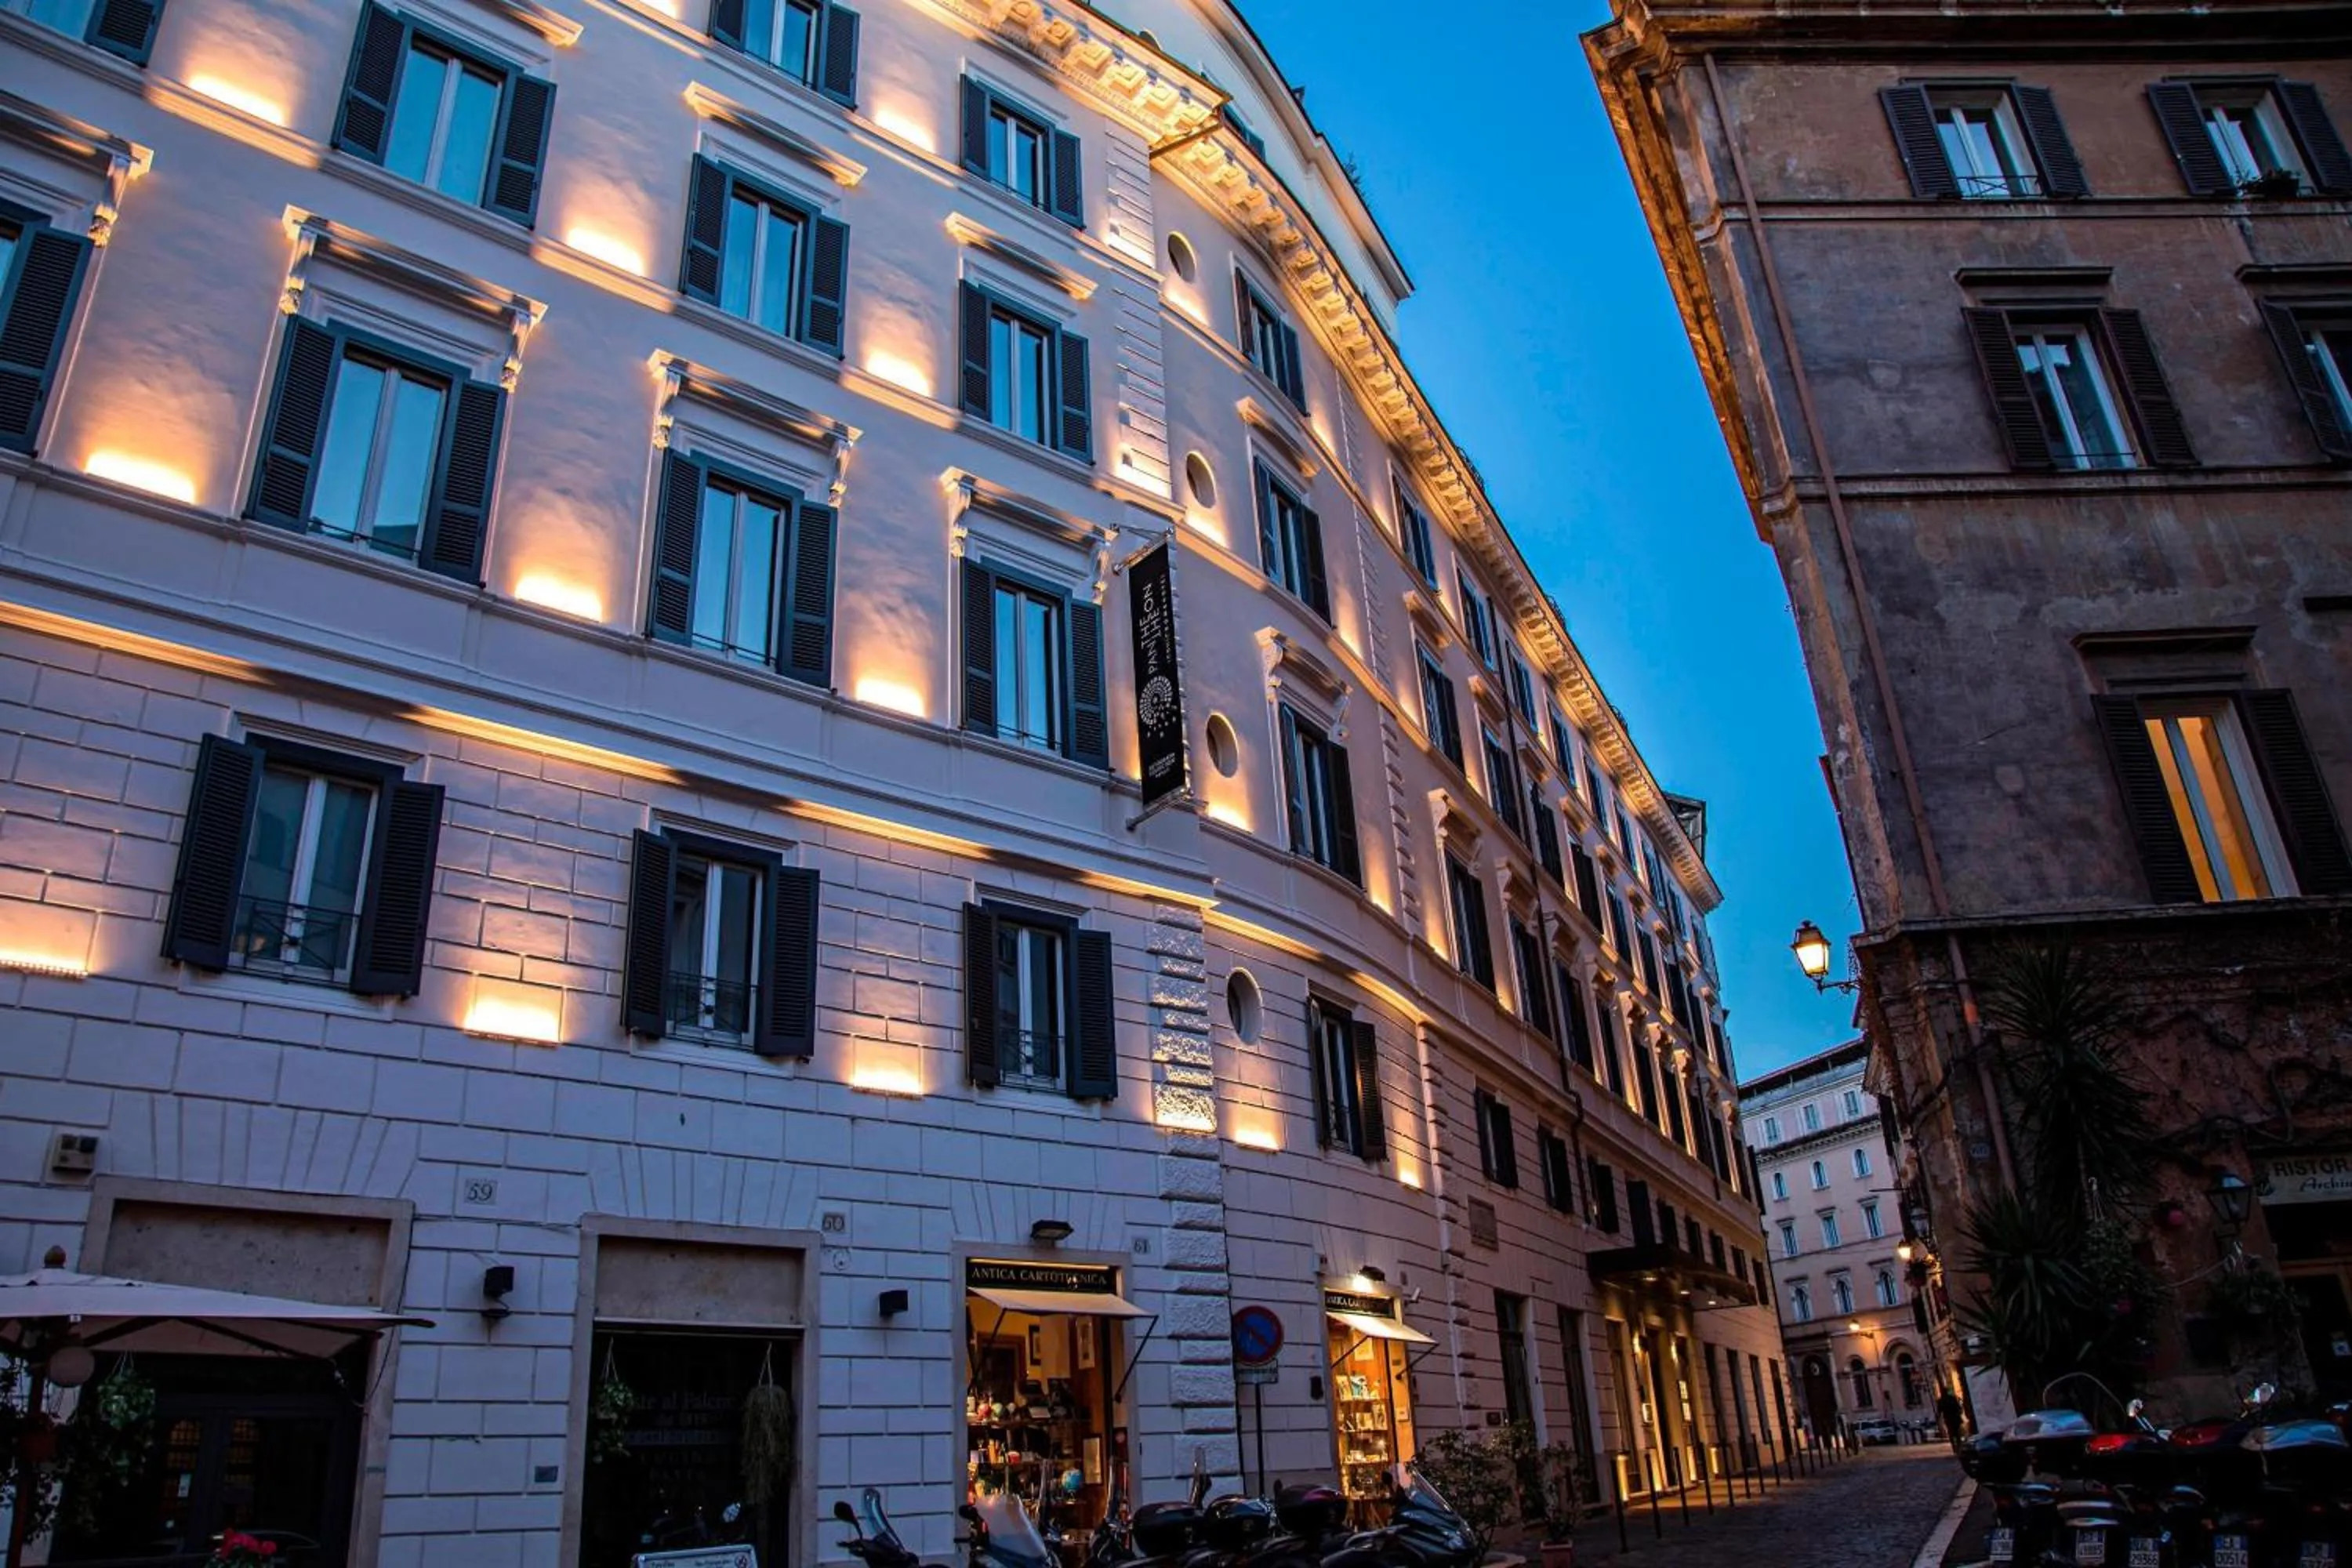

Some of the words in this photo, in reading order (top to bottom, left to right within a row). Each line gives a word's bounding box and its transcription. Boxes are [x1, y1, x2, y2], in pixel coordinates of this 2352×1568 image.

[467, 1182, 492, 1202] 59
[1134, 1238, 1149, 1254] 61
[971, 1267, 1016, 1280] ANTICA
